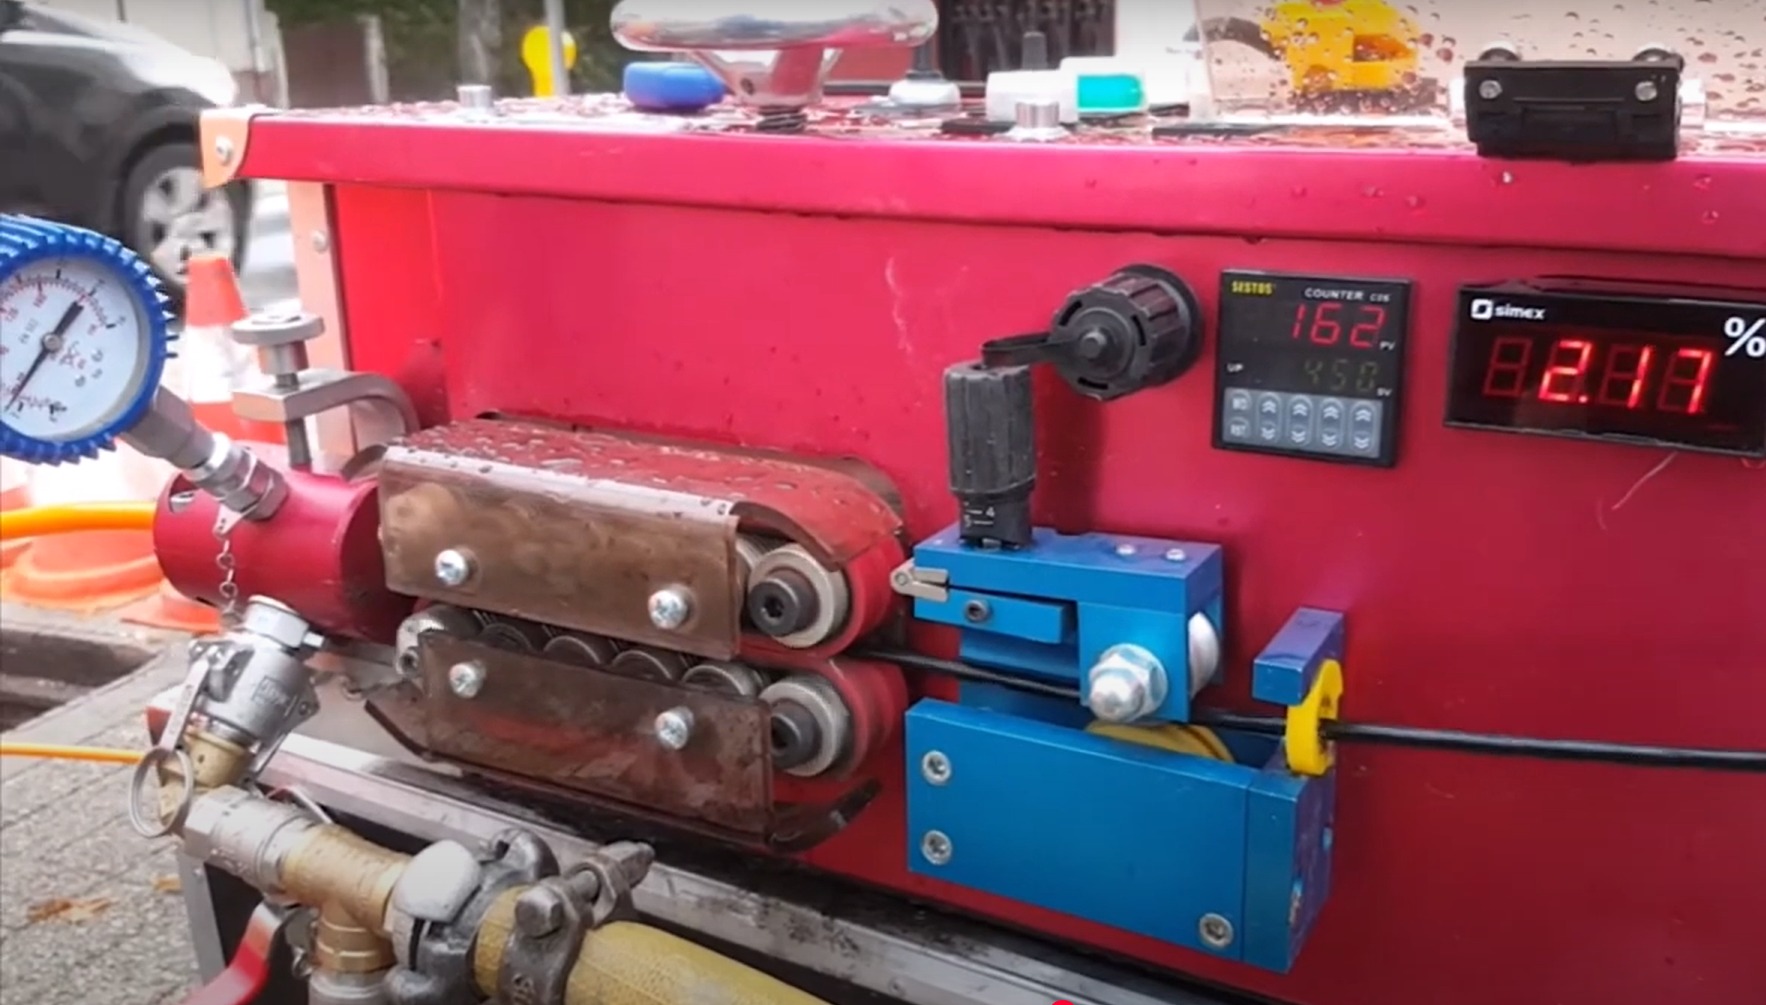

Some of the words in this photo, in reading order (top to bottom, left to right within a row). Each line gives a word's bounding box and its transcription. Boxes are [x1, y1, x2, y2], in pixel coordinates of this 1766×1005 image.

[1304, 287, 1364, 301] COUNTER
[1494, 303, 1546, 320] simex
[1291, 302, 1386, 348] 162
[1724, 316, 1766, 358] %
[1227, 363, 1244, 373] UP
[1304, 358, 1380, 393] 450
[1537, 339, 1715, 415] 2.17
[985, 507, 996, 518] 4
